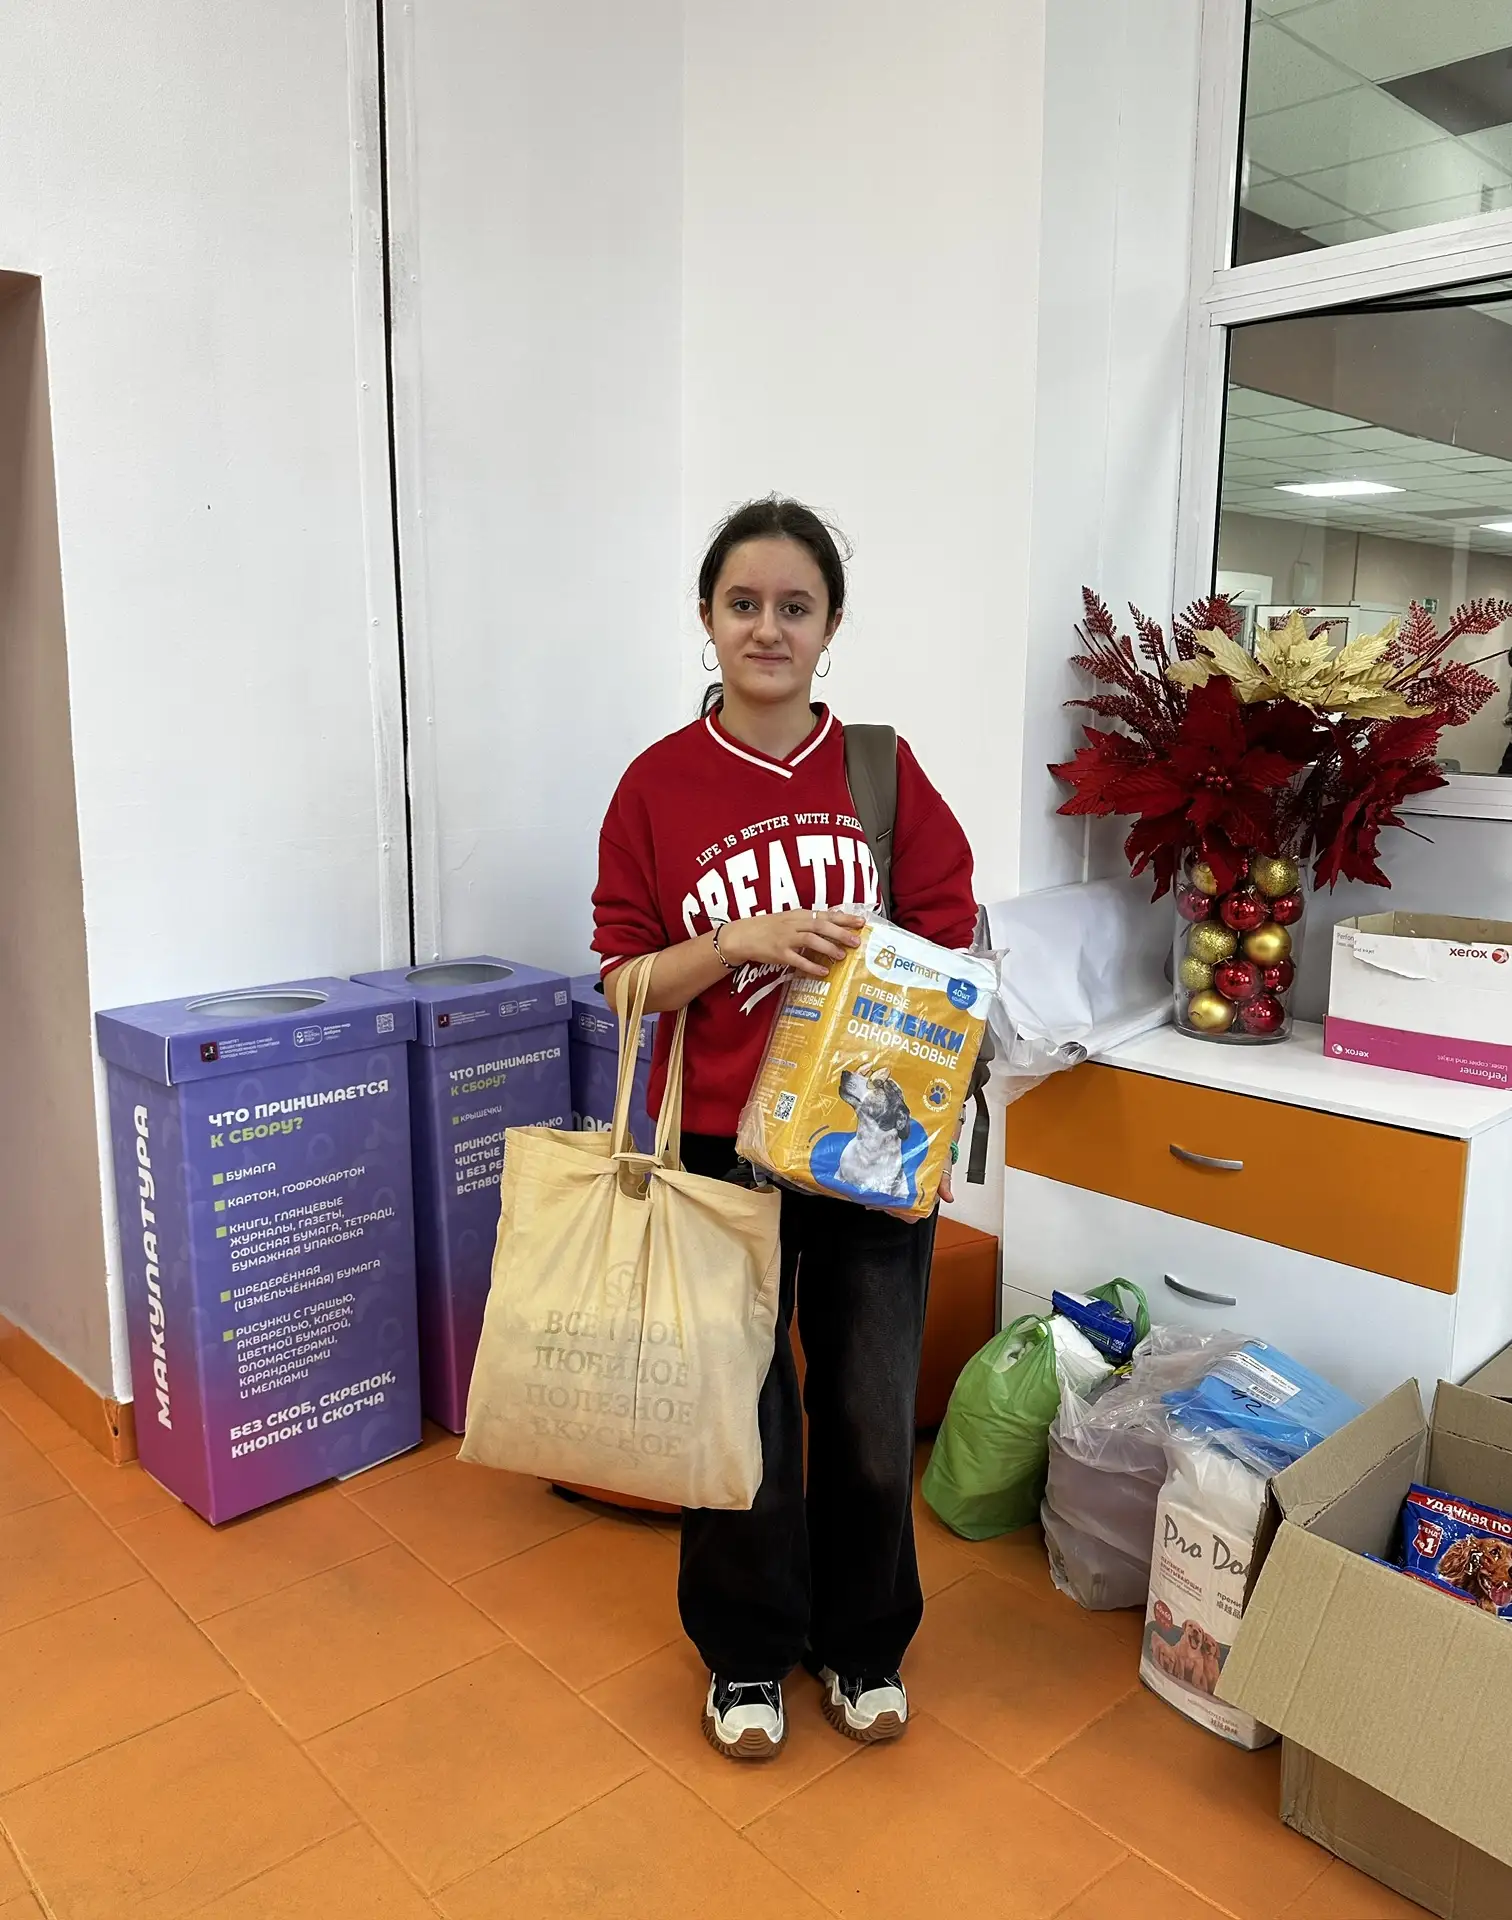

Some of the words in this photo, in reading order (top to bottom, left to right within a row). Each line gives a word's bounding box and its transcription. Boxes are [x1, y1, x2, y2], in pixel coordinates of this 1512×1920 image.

[695, 843, 722, 867] LIFE
[723, 834, 738, 848] IS
[740, 815, 790, 840] BETTER
[794, 813, 830, 825] WITH
[835, 814, 865, 833] FRIE
[893, 956, 942, 983] petmart
[1449, 947, 1488, 960] xerox
[859, 983, 910, 1010] ГЕЛЕВЫЕ
[851, 996, 966, 1055] ПЕЛЕНКИ
[846, 1020, 960, 1070] ОДНОРАЗОВЫЕ
[1345, 1047, 1369, 1058] xerox
[450, 1067, 474, 1082] ЧТО
[476, 1048, 561, 1074] ПРИНИМАЕТСЯ
[1460, 1066, 1508, 1082] Performer
[208, 1108, 250, 1127] ЧТО
[254, 1079, 389, 1119] ПРИНИМАЕТСЯ
[451, 1084, 459, 1096] К
[462, 1074, 506, 1094] СБОРУ?
[460, 1104, 502, 1122] КРЫШЕЧКИ
[529, 1116, 564, 1128] ОЛЬКО
[210, 1132, 224, 1148] К
[229, 1117, 304, 1144] СБОРУ?
[226, 1162, 276, 1182] БУМАГА
[455, 1146, 500, 1167] ЧИСТЫЕ
[456, 1172, 464, 1182] И
[466, 1164, 486, 1178] БЕЗ
[228, 1188, 280, 1208] КАРТОН,
[282, 1166, 365, 1194] ГОФРОКАРТОН
[456, 1173, 502, 1196] ВСТАВО
[230, 1216, 272, 1234] КНИГИ,
[274, 1196, 344, 1222] ГЛЯНЦЕВЫЕ
[230, 1222, 296, 1247] ЖУРНАЛЫ,
[298, 1209, 345, 1229] ГАЗЕТЫ,
[231, 1236, 290, 1260] ОФИСНАЯ
[294, 1222, 342, 1243] БУМАГА,
[344, 1207, 395, 1228] ТЕТРАДИ,
[134, 1104, 172, 1430] МАКУЛАТУРА
[232, 1246, 301, 1272] БУМАЖНАЯ
[304, 1228, 364, 1253] УПАКОВКА
[233, 1264, 321, 1298] ШРЕДЕРЁННАЯ
[234, 1272, 335, 1312] (ИЗМЕЛЬЧЁННАЯ)
[337, 1260, 381, 1280] БУМАГА
[236, 1313, 291, 1337] РИСУНКИ
[294, 1310, 302, 1319] С
[304, 1293, 356, 1316] ГУАШЬЮ,
[236, 1320, 312, 1350] АКВАРЕЛЬЮ,
[314, 1306, 354, 1326] КЛЕЕМ,
[237, 1336, 293, 1363] ЦВЕТНОЙ
[295, 1318, 351, 1343] БУМАГОЙ,
[238, 1335, 338, 1374] ФЛОМАСТЕРАМИ,
[239, 1349, 331, 1387] КАРАНДАШАМИ
[240, 1390, 248, 1399] И
[251, 1369, 309, 1396] МЕЛКАМИ
[230, 1419, 263, 1440] БЕЗ
[266, 1401, 316, 1426] СКОБ,
[319, 1371, 396, 1407] СКРЕПОК,
[524, 1383, 694, 1426] ПОЛЕЗНОЕ
[231, 1422, 303, 1459] КНОПОК
[306, 1416, 318, 1430] И
[322, 1392, 385, 1424] СКОТЧА
[1164, 1514, 1202, 1558] Pro
